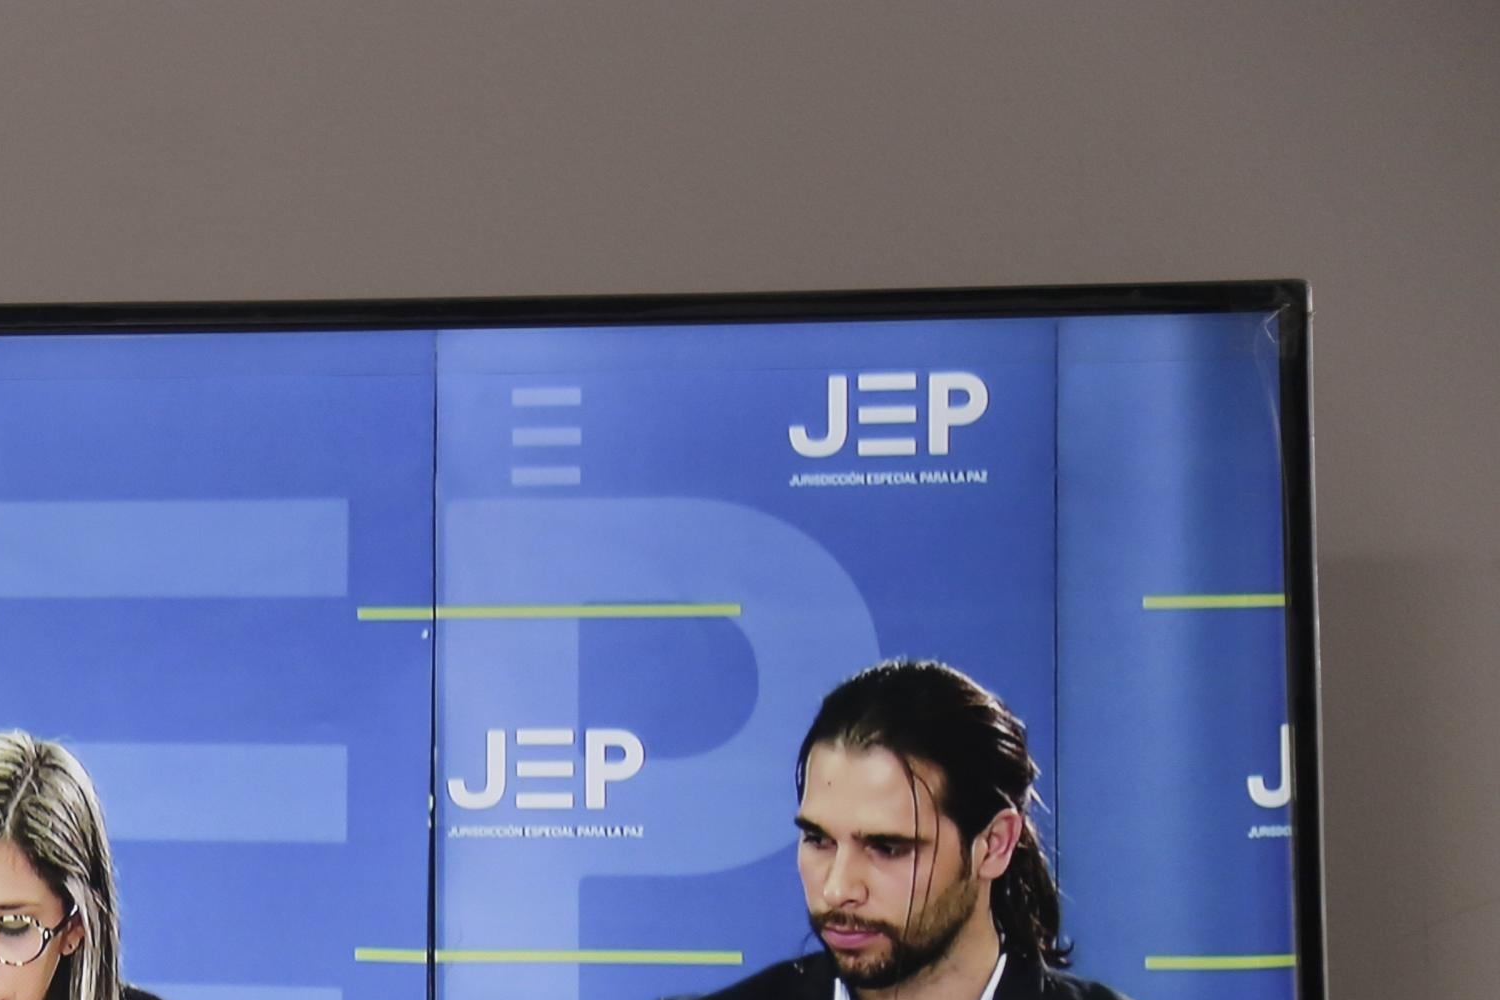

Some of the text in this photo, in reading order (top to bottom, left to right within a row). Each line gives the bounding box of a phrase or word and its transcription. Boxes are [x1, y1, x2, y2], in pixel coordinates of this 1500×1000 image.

[788, 371, 989, 458] JEP
[867, 471, 918, 485] ESPECIAL
[920, 471, 949, 484] PARA
[950, 471, 965, 484] LA
[966, 470, 988, 483] PAZ
[447, 728, 645, 809] JEP
[577, 825, 606, 838] PARA
[607, 825, 623, 838] LA
